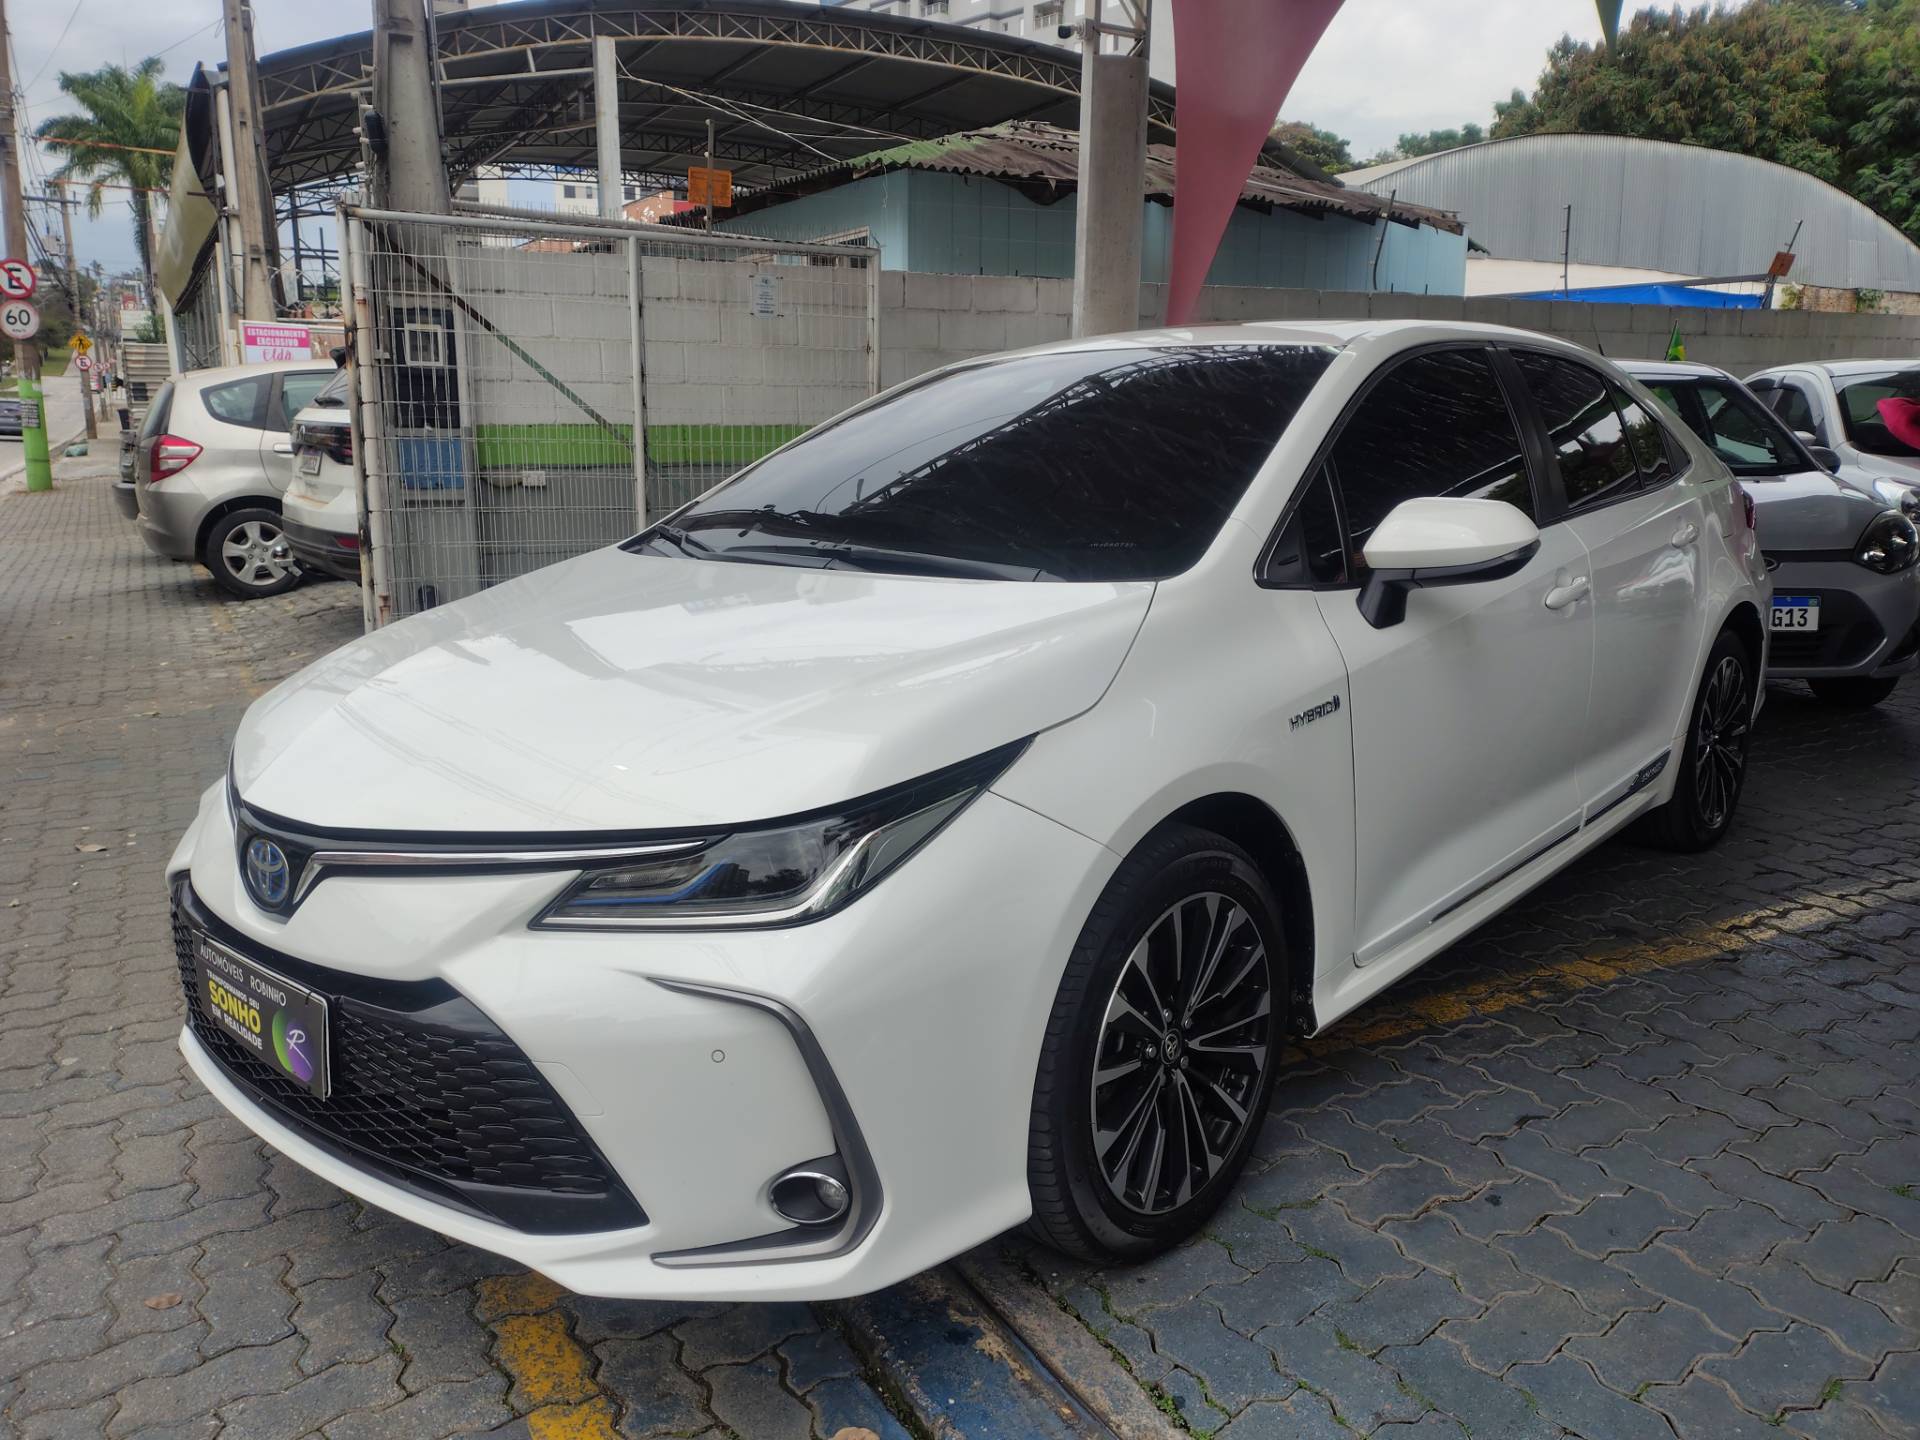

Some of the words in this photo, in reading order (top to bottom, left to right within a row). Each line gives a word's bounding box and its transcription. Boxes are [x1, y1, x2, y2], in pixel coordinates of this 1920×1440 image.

[8, 267, 23, 289] E
[6, 309, 31, 326] 60
[247, 327, 307, 339] ESTACIONAMENTO
[257, 337, 299, 347] EXCLUSIVO
[1289, 700, 1335, 732] HYBRID
[200, 944, 244, 983] AUTOMÓVEIS
[249, 975, 287, 1007] ROBINHO
[208, 979, 262, 1034] SONHO
[248, 997, 260, 1009] SEU
[211, 1003, 222, 1020] EM
[224, 1013, 263, 1050] REALIDADE
[286, 1029, 313, 1070] R
